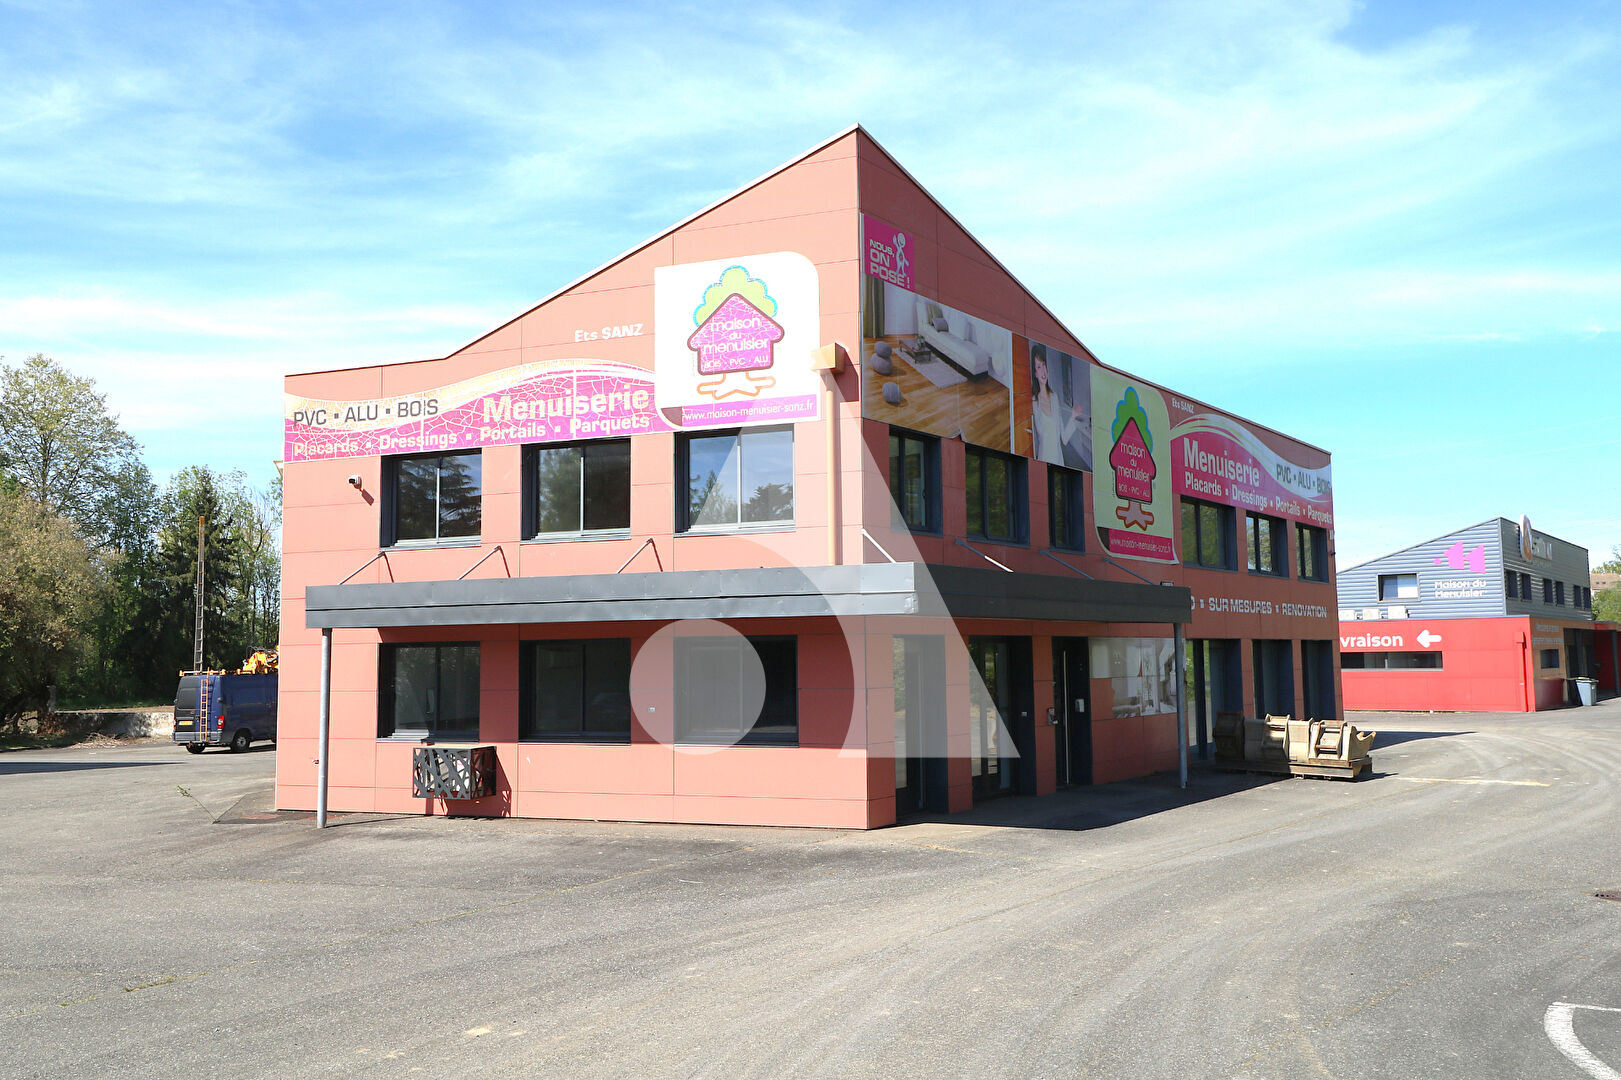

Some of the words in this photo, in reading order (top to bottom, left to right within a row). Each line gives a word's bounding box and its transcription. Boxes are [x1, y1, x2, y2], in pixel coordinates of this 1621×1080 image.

[869, 248, 890, 268] ON
[574, 329, 599, 342] Ets
[601, 323, 644, 340] SANZ
[711, 317, 760, 332] maison
[728, 332, 742, 340] du
[703, 337, 769, 354] menuisier
[729, 358, 745, 366] PVC
[753, 355, 769, 363] ALU
[483, 384, 649, 423] Menuiserie
[683, 398, 815, 420] www.maison-menuisier-sanz.fr
[293, 409, 327, 427] PVC
[344, 404, 378, 423] ALU
[397, 399, 438, 417] BOIS
[294, 438, 359, 457] Placards
[380, 432, 458, 450] Dressings
[480, 423, 546, 441] Portails
[569, 414, 650, 435] Parquets
[1120, 442, 1146, 459] maison
[1130, 458, 1137, 467] du
[1183, 437, 1260, 487] Menuiserie
[1117, 466, 1150, 482] menuisier
[1276, 464, 1291, 484] PVC
[1298, 471, 1311, 489] ALU
[1184, 471, 1222, 497] Placards
[1231, 484, 1268, 511] Dressings
[1275, 496, 1300, 516] Portails
[1307, 505, 1332, 525] Parquets
[1434, 579, 1470, 589] Maison
[1472, 579, 1487, 588] du
[1281, 602, 1328, 618] RENOVATION
